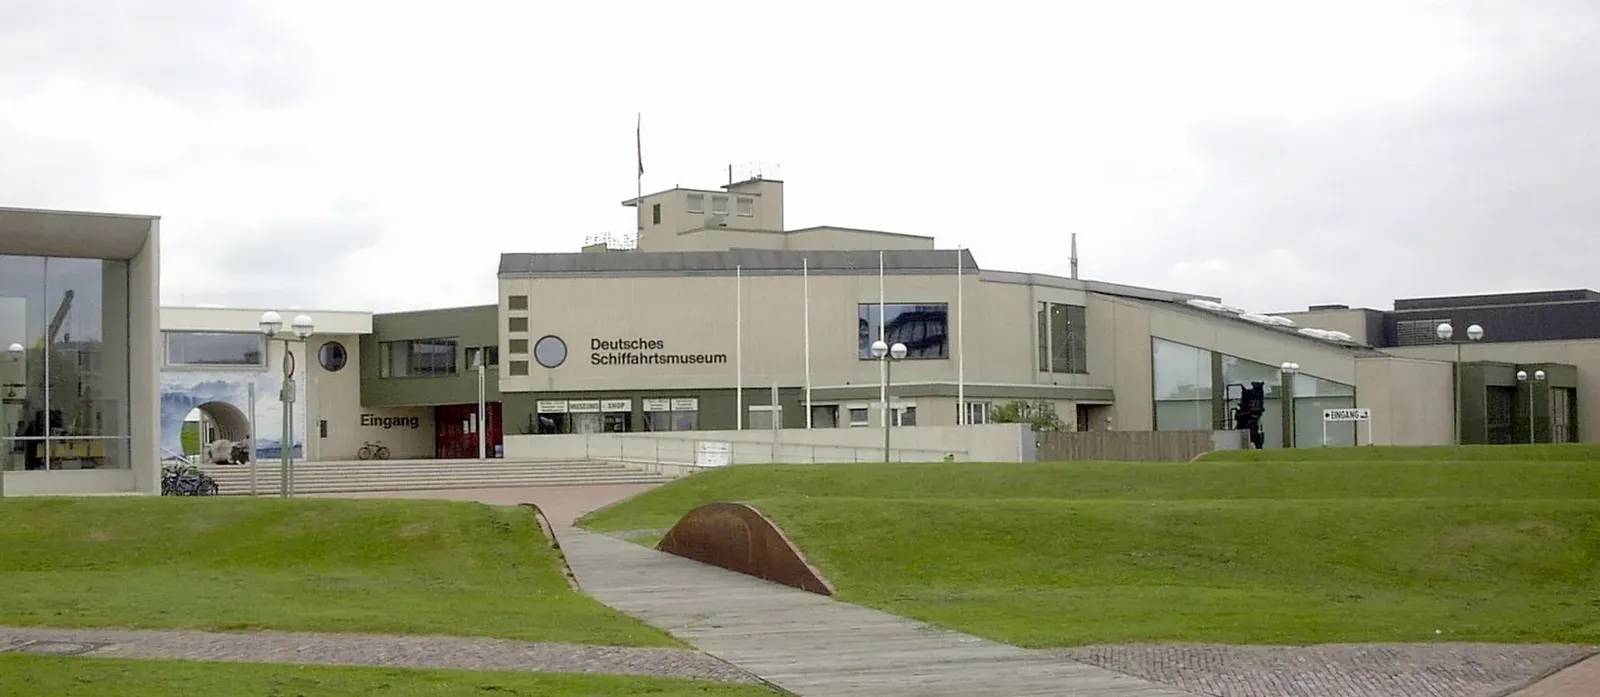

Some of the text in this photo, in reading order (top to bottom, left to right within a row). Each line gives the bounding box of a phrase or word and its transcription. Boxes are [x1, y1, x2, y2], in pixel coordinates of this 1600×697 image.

[591, 338, 664, 350] Deutsches
[591, 352, 727, 365] Schiffahrtsmuseum
[1331, 410, 1359, 419] EINGANG
[361, 414, 419, 429] Eingang
